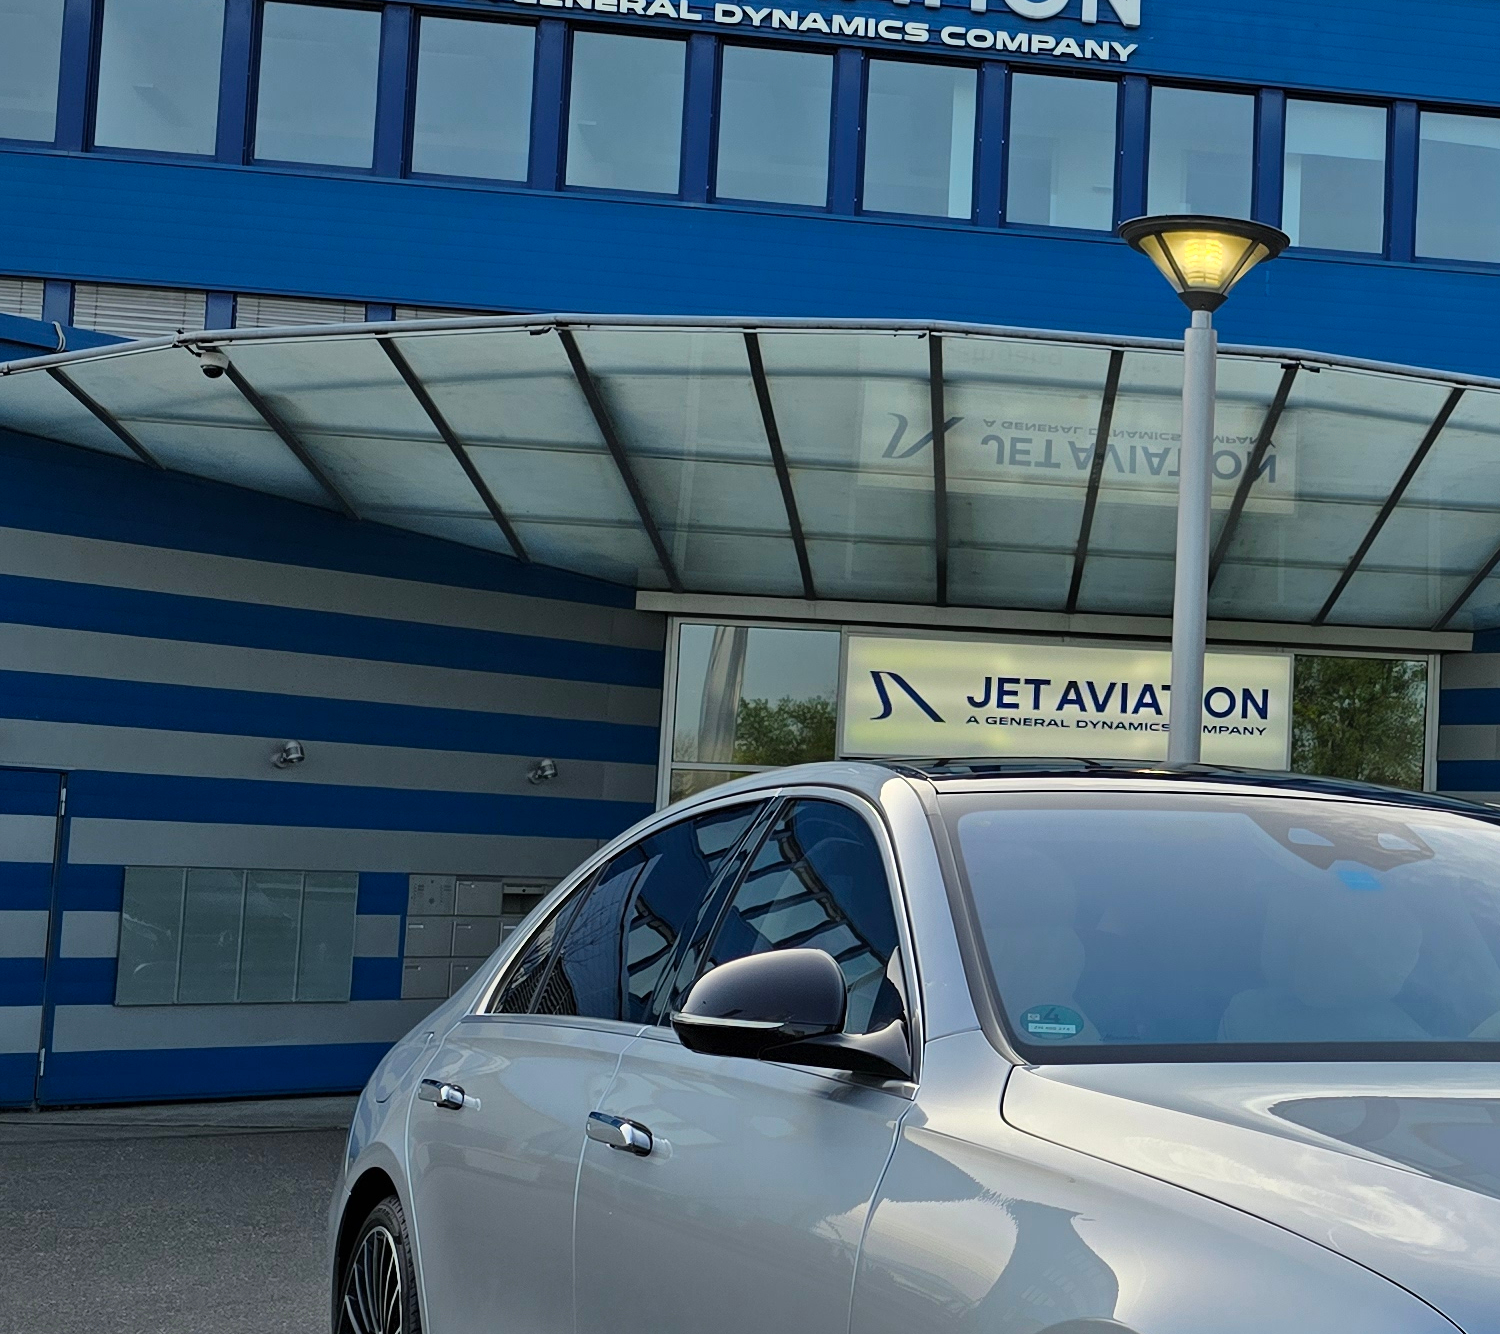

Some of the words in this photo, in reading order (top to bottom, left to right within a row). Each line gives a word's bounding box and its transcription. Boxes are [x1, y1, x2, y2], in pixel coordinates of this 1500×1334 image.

[715, 4, 930, 43] DYNAMICS
[940, 25, 1138, 63] COMPANY
[1056, 680, 1269, 721] AVIAON
[965, 716, 980, 725] A
[985, 716, 1071, 728] GENERAL
[1076, 719, 1170, 733] DYNAMICS
[1202, 724, 1267, 737] MPANY
[1043, 1007, 1061, 1023] 4
